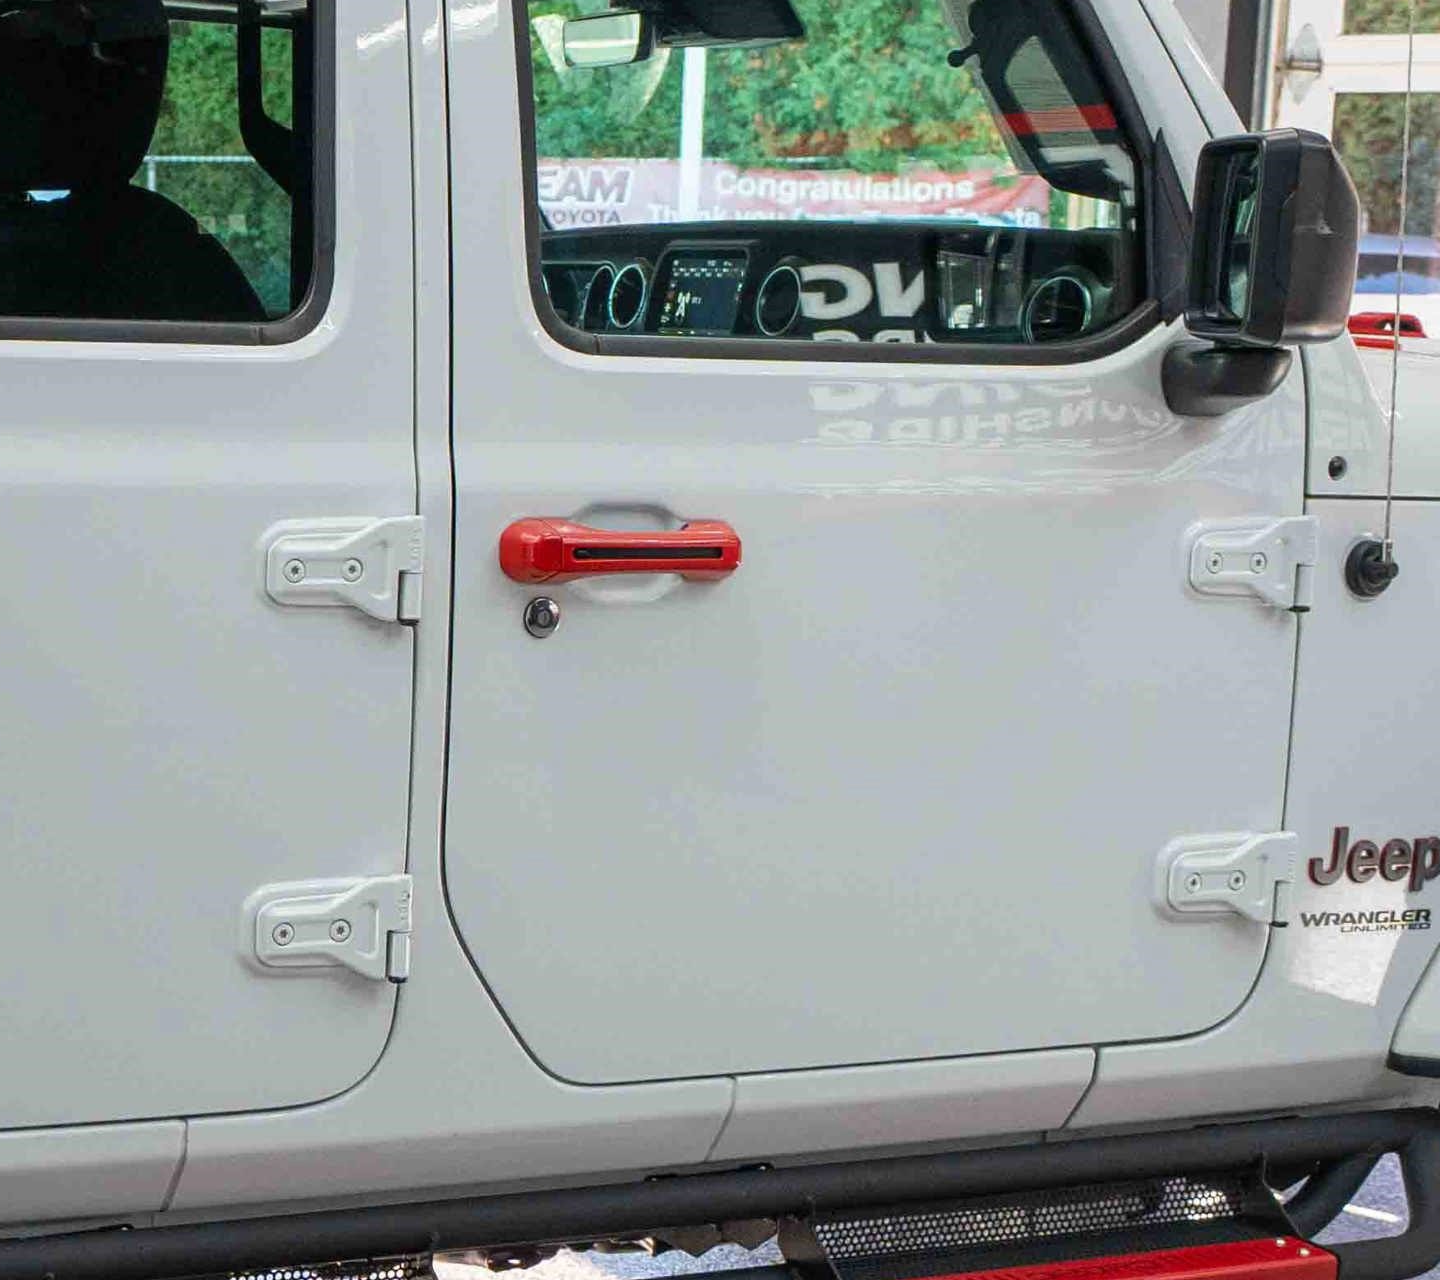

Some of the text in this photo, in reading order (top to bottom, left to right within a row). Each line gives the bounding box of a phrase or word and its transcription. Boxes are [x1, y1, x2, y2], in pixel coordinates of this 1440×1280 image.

[538, 170, 631, 203] EAM
[718, 170, 975, 204] Congratulations
[544, 209, 621, 224] OYOTA
[1301, 908, 1431, 928] WRANGLER
[1340, 923, 1432, 933] UNLIMITED
